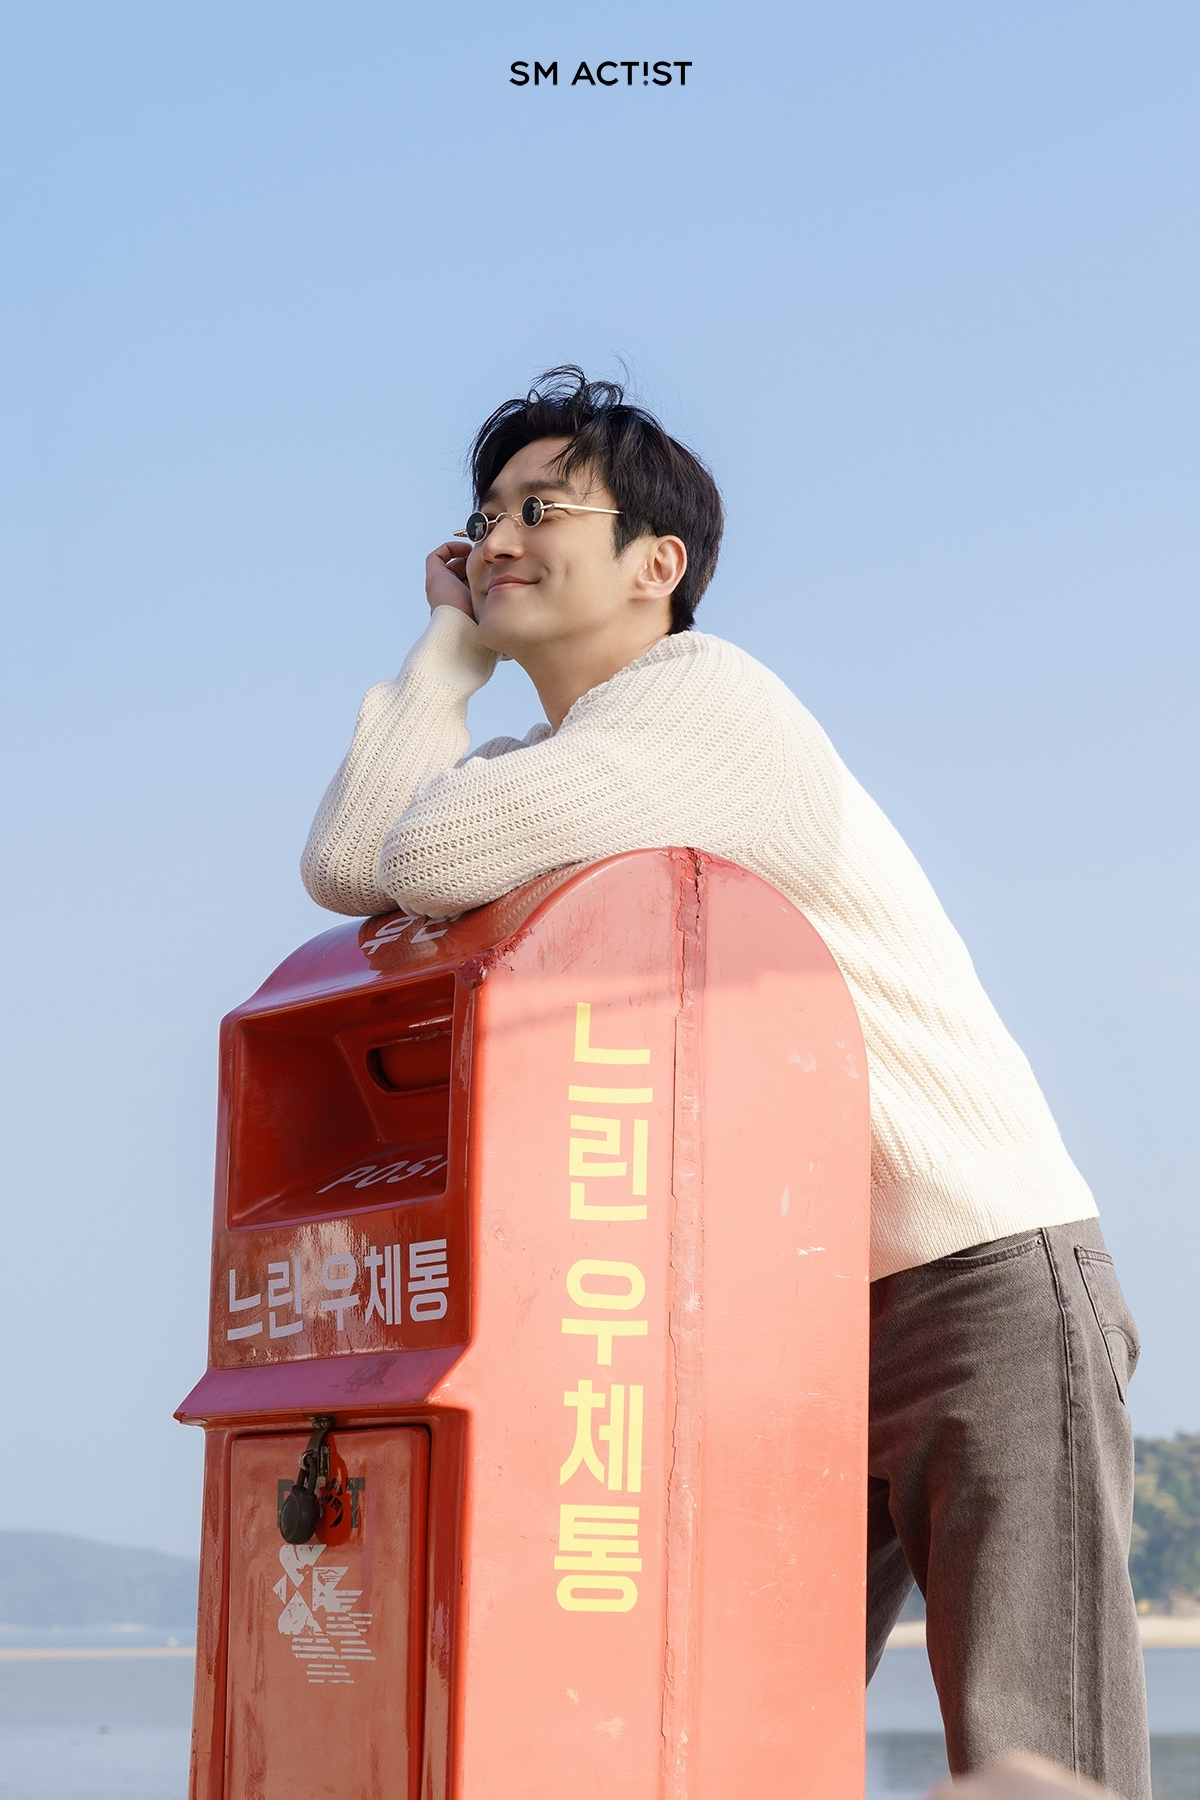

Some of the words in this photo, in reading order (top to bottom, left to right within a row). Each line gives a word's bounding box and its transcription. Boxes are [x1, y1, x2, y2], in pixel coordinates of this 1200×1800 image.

[568, 1002, 653, 1221] 느린
[227, 1258, 303, 1341] 느린
[321, 1238, 449, 1331] 우체통
[554, 1259, 648, 1612] 우체통
